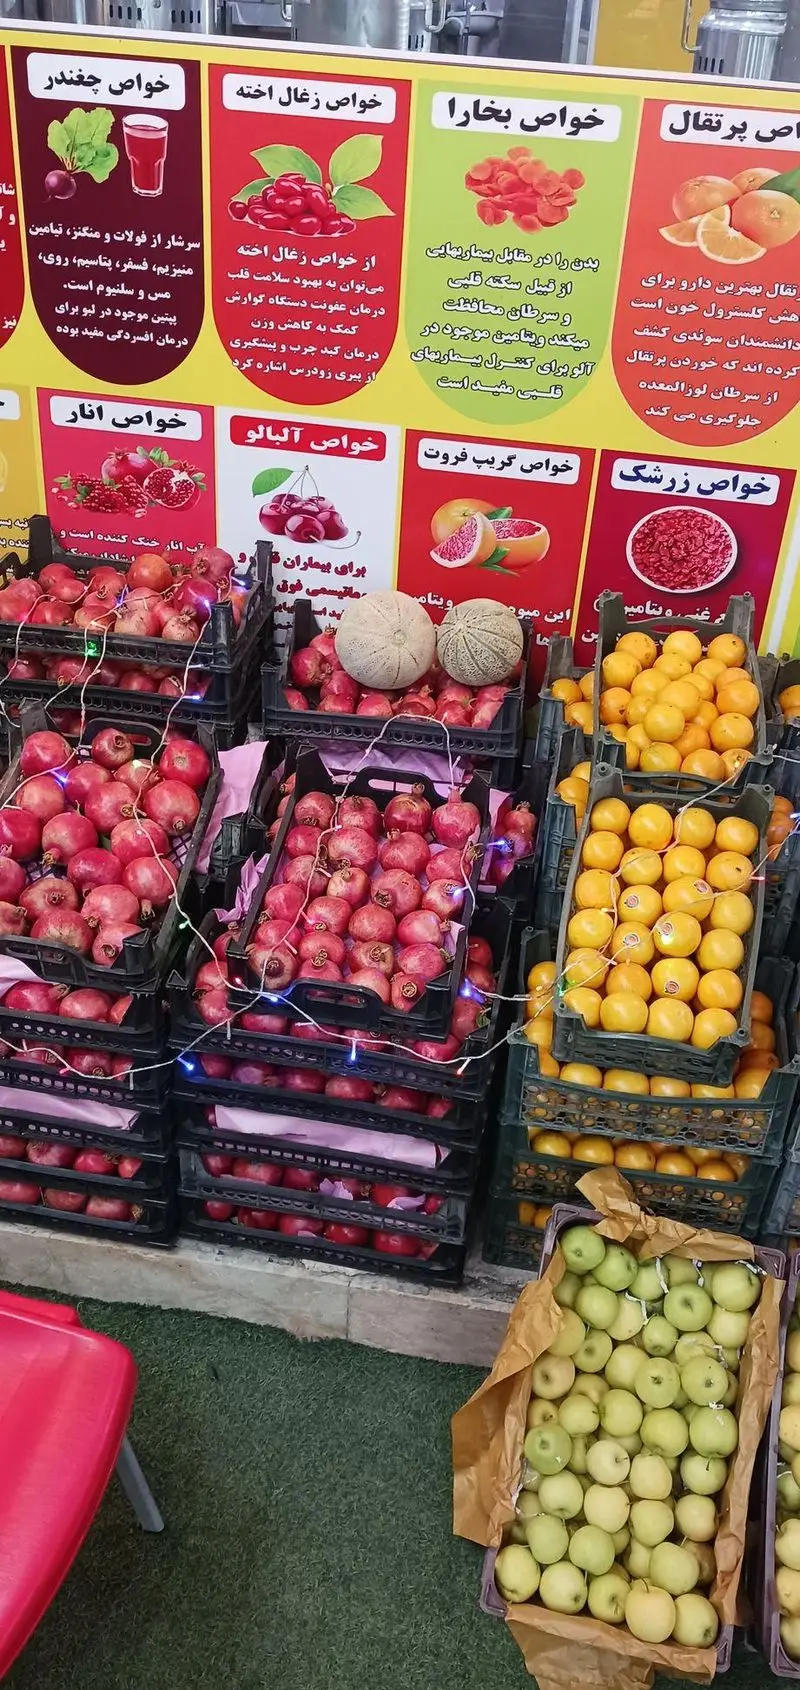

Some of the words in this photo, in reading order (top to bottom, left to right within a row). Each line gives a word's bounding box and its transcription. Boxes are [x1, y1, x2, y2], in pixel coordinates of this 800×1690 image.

[44, 69, 101, 94] چغندر
[108, 73, 170, 98] خواص
[236, 84, 273, 101] اخته
[278, 87, 320, 109] زغال
[326, 92, 382, 113] خواص
[448, 97, 512, 131] بخارا
[520, 105, 605, 136] خواص
[669, 110, 748, 143] پرتقال
[29, 223, 63, 236] تیامین
[104, 232, 110, 243] و
[113, 229, 147, 247] فولات
[151, 234, 161, 247] از
[165, 235, 201, 250] سرشار
[237, 244, 268, 257] اخته
[272, 247, 307, 265] زغال
[496, 247, 532, 264] مقابل
[311, 252, 357, 269] خواص
[361, 256, 376, 271] از
[534, 253, 552, 268] در
[555, 252, 568, 270] را
[571, 256, 600, 272] بدن
[227, 267, 249, 281] قلب
[253, 271, 290, 283] سلامت
[448, 271, 483, 288] قلبی
[641, 271, 677, 290] برای
[293, 276, 322, 288] بهبود
[325, 280, 337, 290] به
[485, 275, 521, 290] سکته
[526, 278, 555, 295] قبیل
[679, 276, 712, 296] دارو
[96, 284, 134, 298] سلنیوم
[138, 287, 144, 299] و
[556, 281, 572, 298] از
[715, 281, 764, 298] بهترین
[268, 295, 307, 307] دستگاه
[311, 301, 346, 313] عفونت
[442, 298, 504, 317] محافظت
[630, 298, 662, 310] است
[665, 300, 699, 316] خون
[55, 302, 79, 315] برای
[82, 305, 95, 316] لبو
[99, 307, 112, 318] در
[114, 309, 148, 322] موجود
[349, 303, 385, 317] درمان
[507, 305, 559, 325] سرطان
[703, 302, 767, 318] کلسترول
[251, 318, 274, 329] وزن
[277, 319, 312, 331] کاهش
[561, 312, 572, 325] و
[56, 325, 79, 337] بوده
[81, 327, 104, 338] مفید
[316, 323, 327, 334] به
[330, 324, 358, 335] کمک
[420, 322, 440, 336] در
[442, 323, 490, 341] موجود
[633, 327, 670, 339] کشف
[156, 334, 189, 348] درمان
[492, 329, 545, 348] ویتامین
[548, 334, 590, 350] میکند
[673, 331, 723, 345] سوئدی
[280, 344, 286, 352] و
[289, 343, 317, 355] چرب
[321, 346, 341, 357] کبد
[344, 348, 379, 361] درمان
[232, 358, 253, 369] کرد
[484, 354, 535, 370] کنترل
[625, 350, 666, 366] پرتقال
[670, 356, 718, 370] خوردن
[256, 361, 287, 372] اشاره
[289, 366, 332, 379] زودرس
[537, 360, 569, 376] برای
[571, 361, 595, 378] آلو
[722, 361, 739, 370] که
[742, 363, 762, 373] اند
[335, 370, 361, 382] پیری
[364, 371, 376, 383] از
[437, 377, 469, 389] است
[471, 379, 514, 395] مفید
[518, 384, 563, 399] قلبی
[639, 380, 707, 397] لوزالمعده
[710, 386, 760, 403] سرطان
[763, 392, 778, 405] از
[66, 403, 103, 423] انار
[645, 405, 670, 416] کند
[673, 411, 696, 421] می
[111, 411, 187, 433] خواص
[245, 423, 304, 445] آلبالو
[310, 434, 379, 456] خواص
[424, 447, 468, 466] فروت
[472, 454, 517, 471] گریپ
[520, 458, 573, 477] خواص
[619, 464, 690, 493] زرشک
[697, 474, 771, 500] خواص
[60, 530, 66, 538] و
[69, 529, 94, 539] است
[97, 534, 128, 544] کننده
[131, 537, 159, 547] خنک
[165, 540, 182, 552] انار
[283, 555, 331, 573] بیماران
[334, 562, 367, 578] برای
[277, 579, 303, 594] فوق
[544, 609, 571, 623] این
